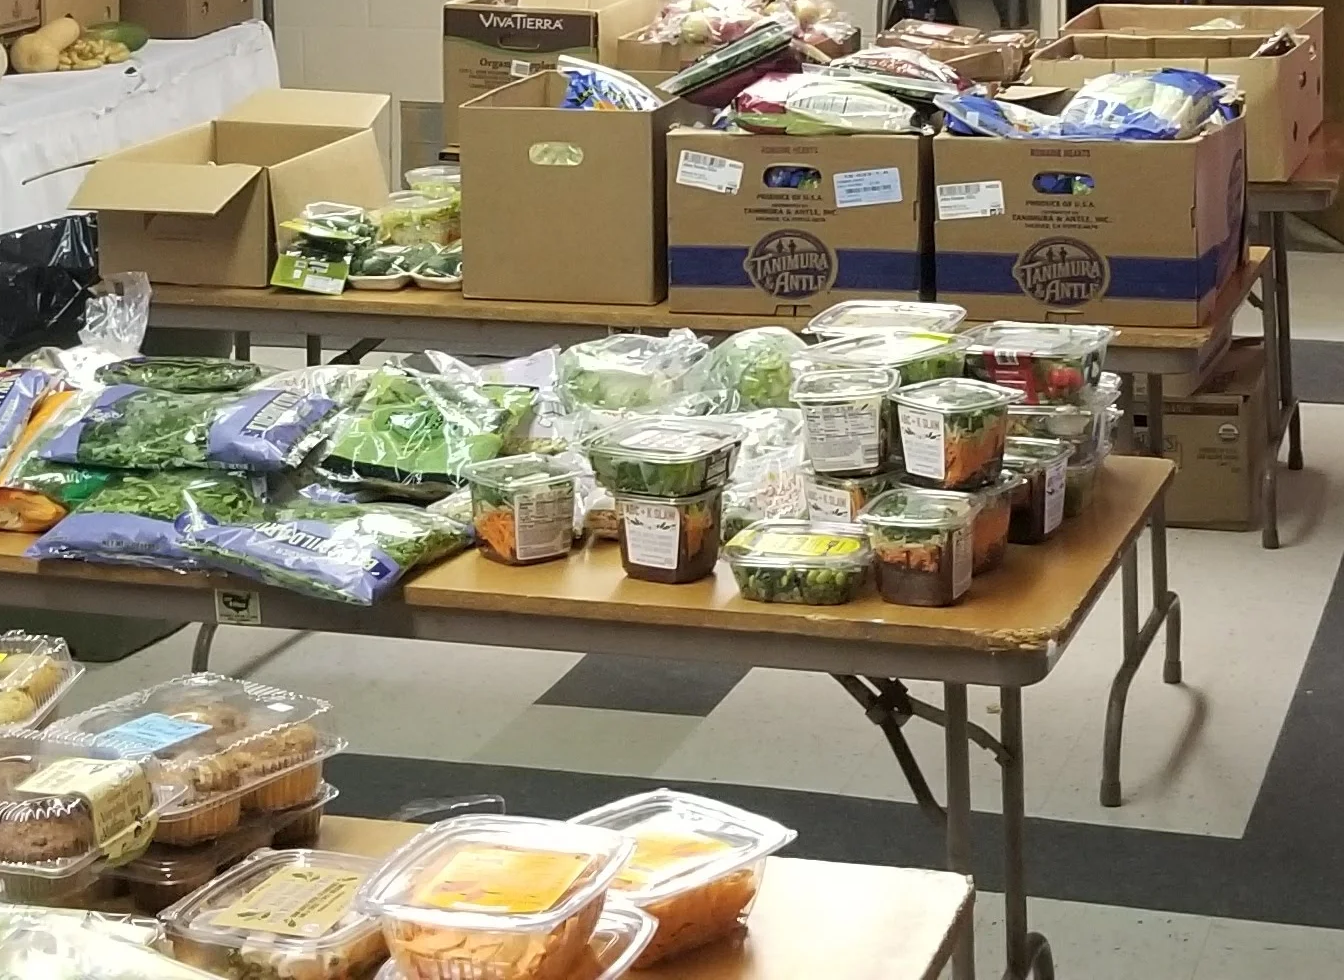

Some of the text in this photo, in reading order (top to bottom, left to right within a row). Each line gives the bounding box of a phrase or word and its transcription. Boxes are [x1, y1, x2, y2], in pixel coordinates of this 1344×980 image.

[480, 58, 511, 69] Organ
[749, 251, 828, 279] TANIMURA
[1020, 260, 1100, 288] TANIMURA
[765, 271, 825, 296] & ANTLE
[1033, 279, 1099, 303] & ANTLE
